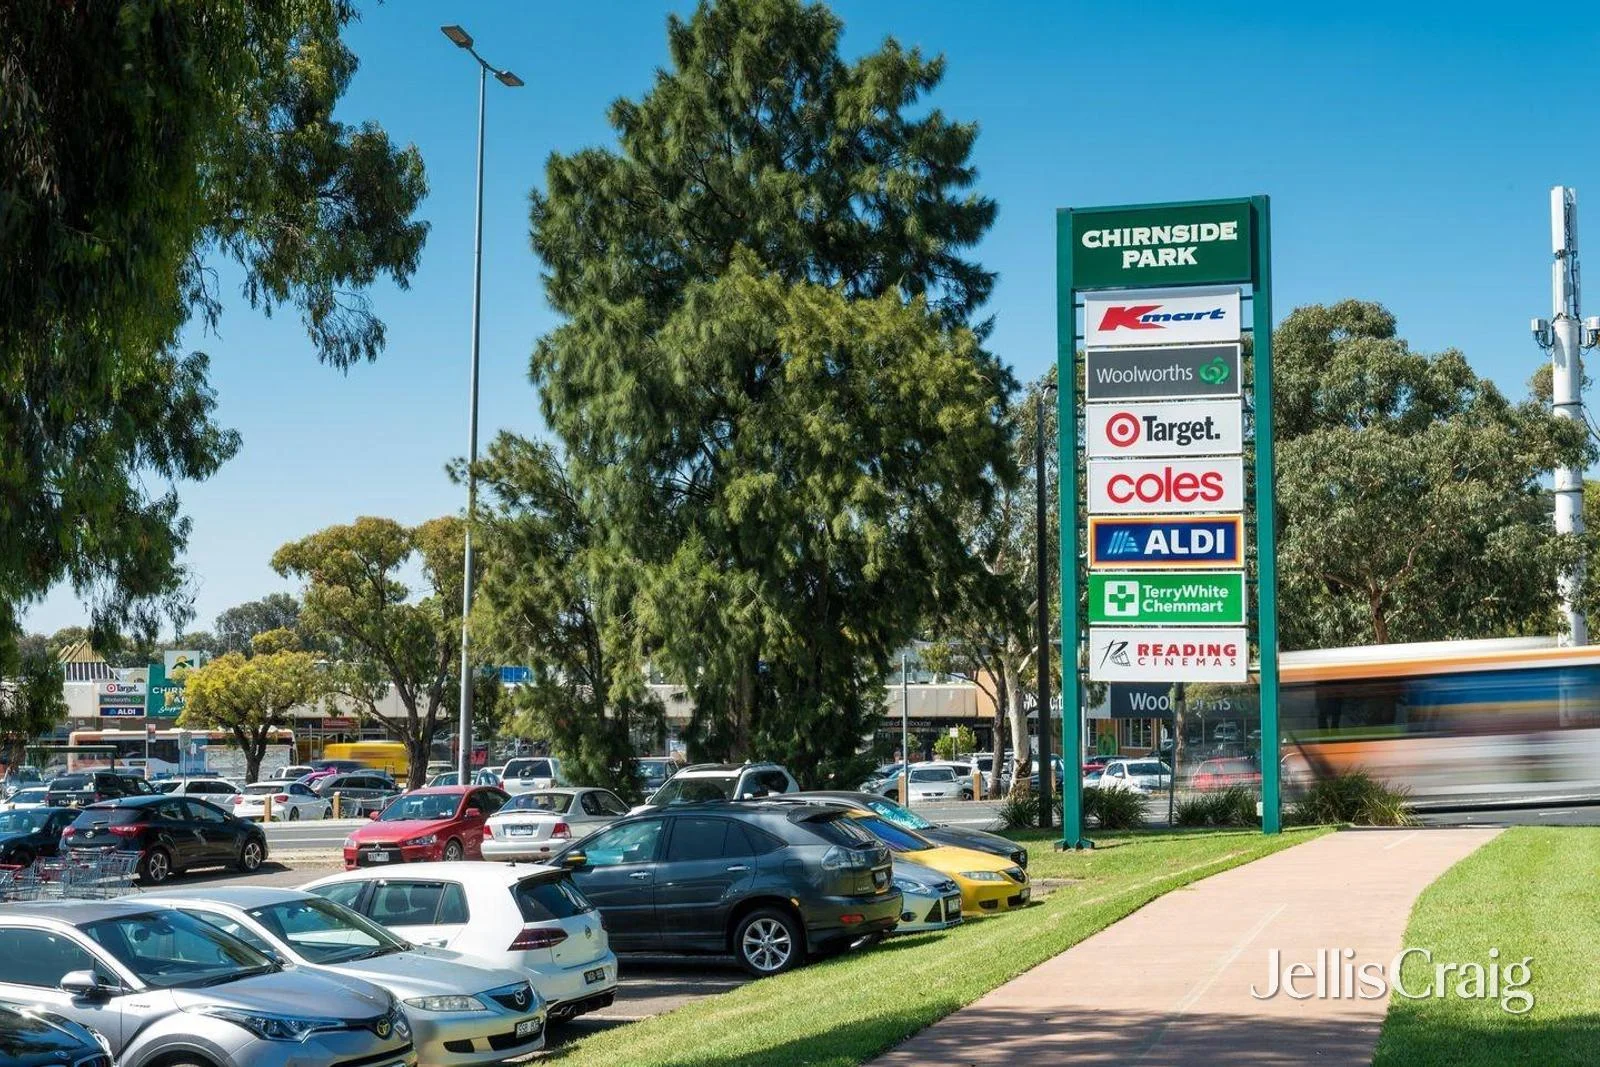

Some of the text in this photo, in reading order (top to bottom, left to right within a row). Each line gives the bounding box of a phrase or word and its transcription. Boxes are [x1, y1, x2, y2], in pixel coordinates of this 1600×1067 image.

[1081, 220, 1238, 248] CHIRNSIDE
[1122, 246, 1198, 268] PARK
[1098, 305, 1226, 331] Kmart
[1096, 364, 1193, 384] Woolworths
[1142, 415, 1221, 446] Target.
[1107, 467, 1224, 504] coles
[1144, 529, 1225, 554] ALDI
[1142, 585, 1229, 601] TerryWhite
[1142, 600, 1224, 613] Chemmart
[1137, 643, 1237, 657] READING
[1137, 657, 1237, 667] CINEMAS
[117, 708, 136, 716] ALDI
